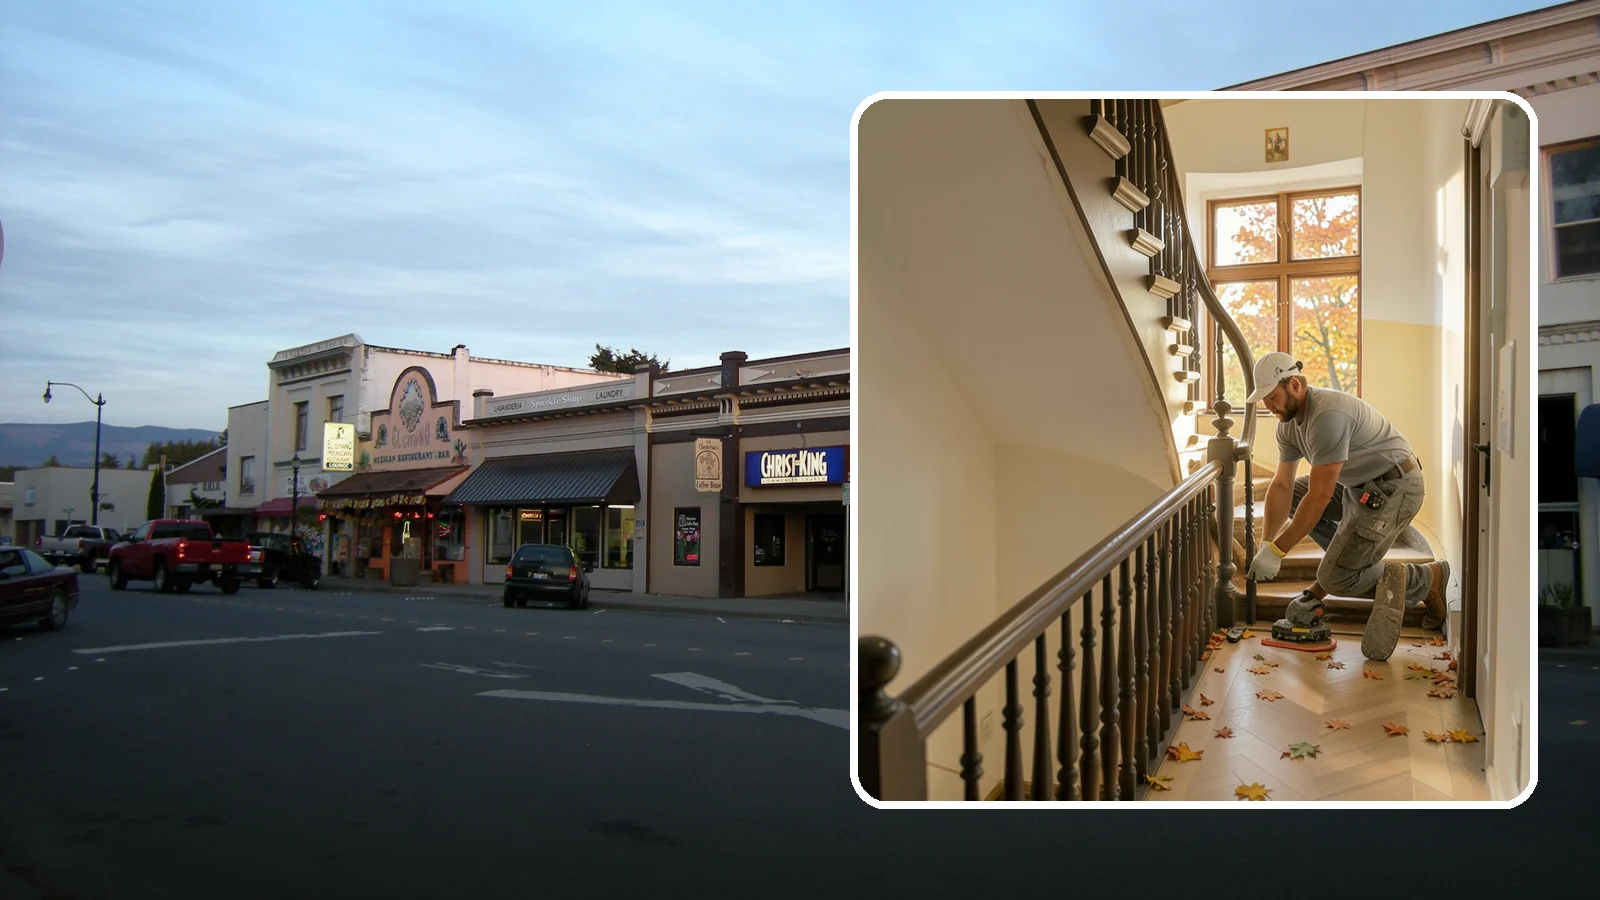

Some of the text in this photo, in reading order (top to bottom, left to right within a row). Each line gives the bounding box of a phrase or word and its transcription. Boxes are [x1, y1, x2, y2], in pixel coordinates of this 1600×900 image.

[531, 394, 582, 409] Sparkle Shop
[596, 389, 623, 400] LAUNDRY
[494, 402, 522, 412] LAVANDERIA
[374, 455, 396, 464] MEXICAN
[398, 452, 433, 462] RESTAURANT
[438, 450, 450, 459] BAR
[761, 450, 827, 477] CHRIST KING
